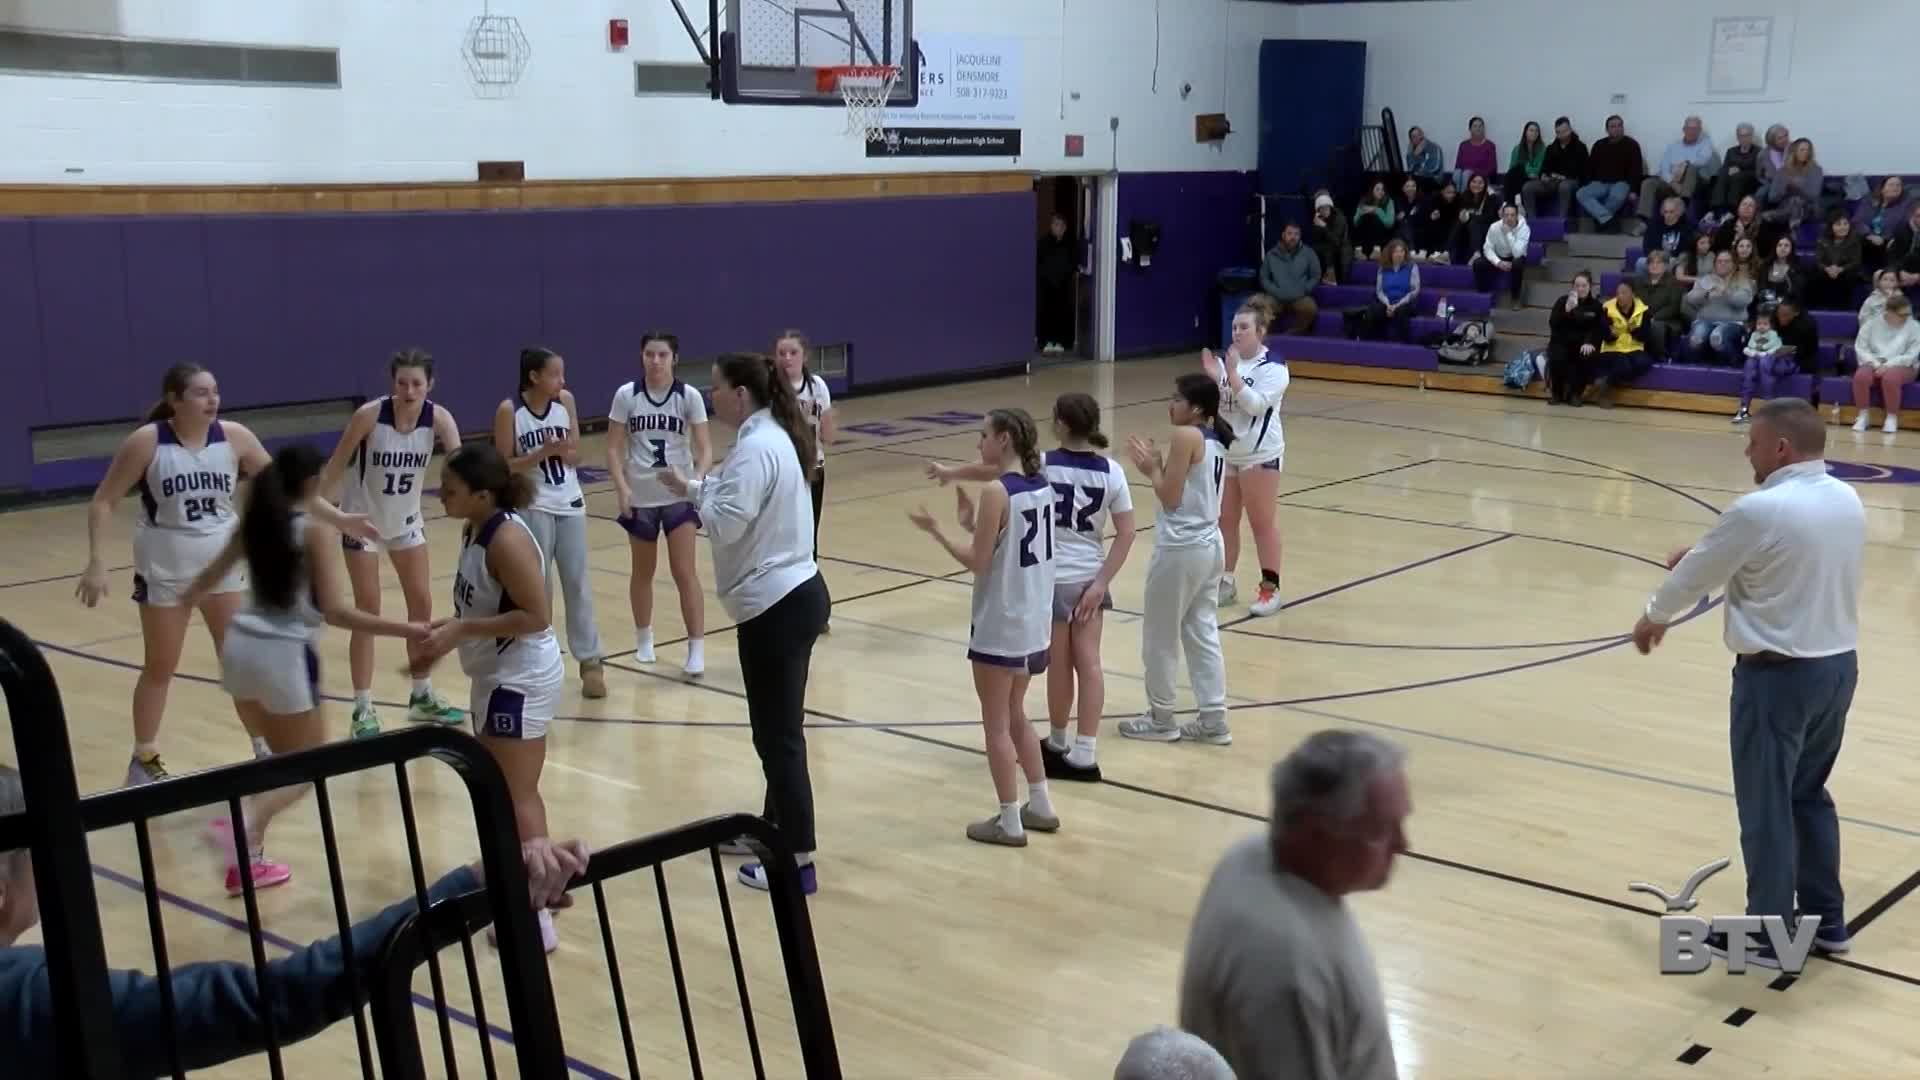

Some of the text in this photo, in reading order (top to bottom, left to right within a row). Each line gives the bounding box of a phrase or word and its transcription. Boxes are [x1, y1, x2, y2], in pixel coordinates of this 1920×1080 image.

[956, 54, 1001, 67] JACQUELINE
[920, 72, 944, 85] ERS
[956, 71, 1000, 82] DENSMORE
[904, 136, 1005, 147] Proud Sponsor of Bourne High School
[648, 439, 668, 467] 3
[162, 471, 231, 497] BOURNE
[383, 473, 415, 495] 15
[184, 497, 218, 521] 24
[1020, 502, 1053, 568] 21
